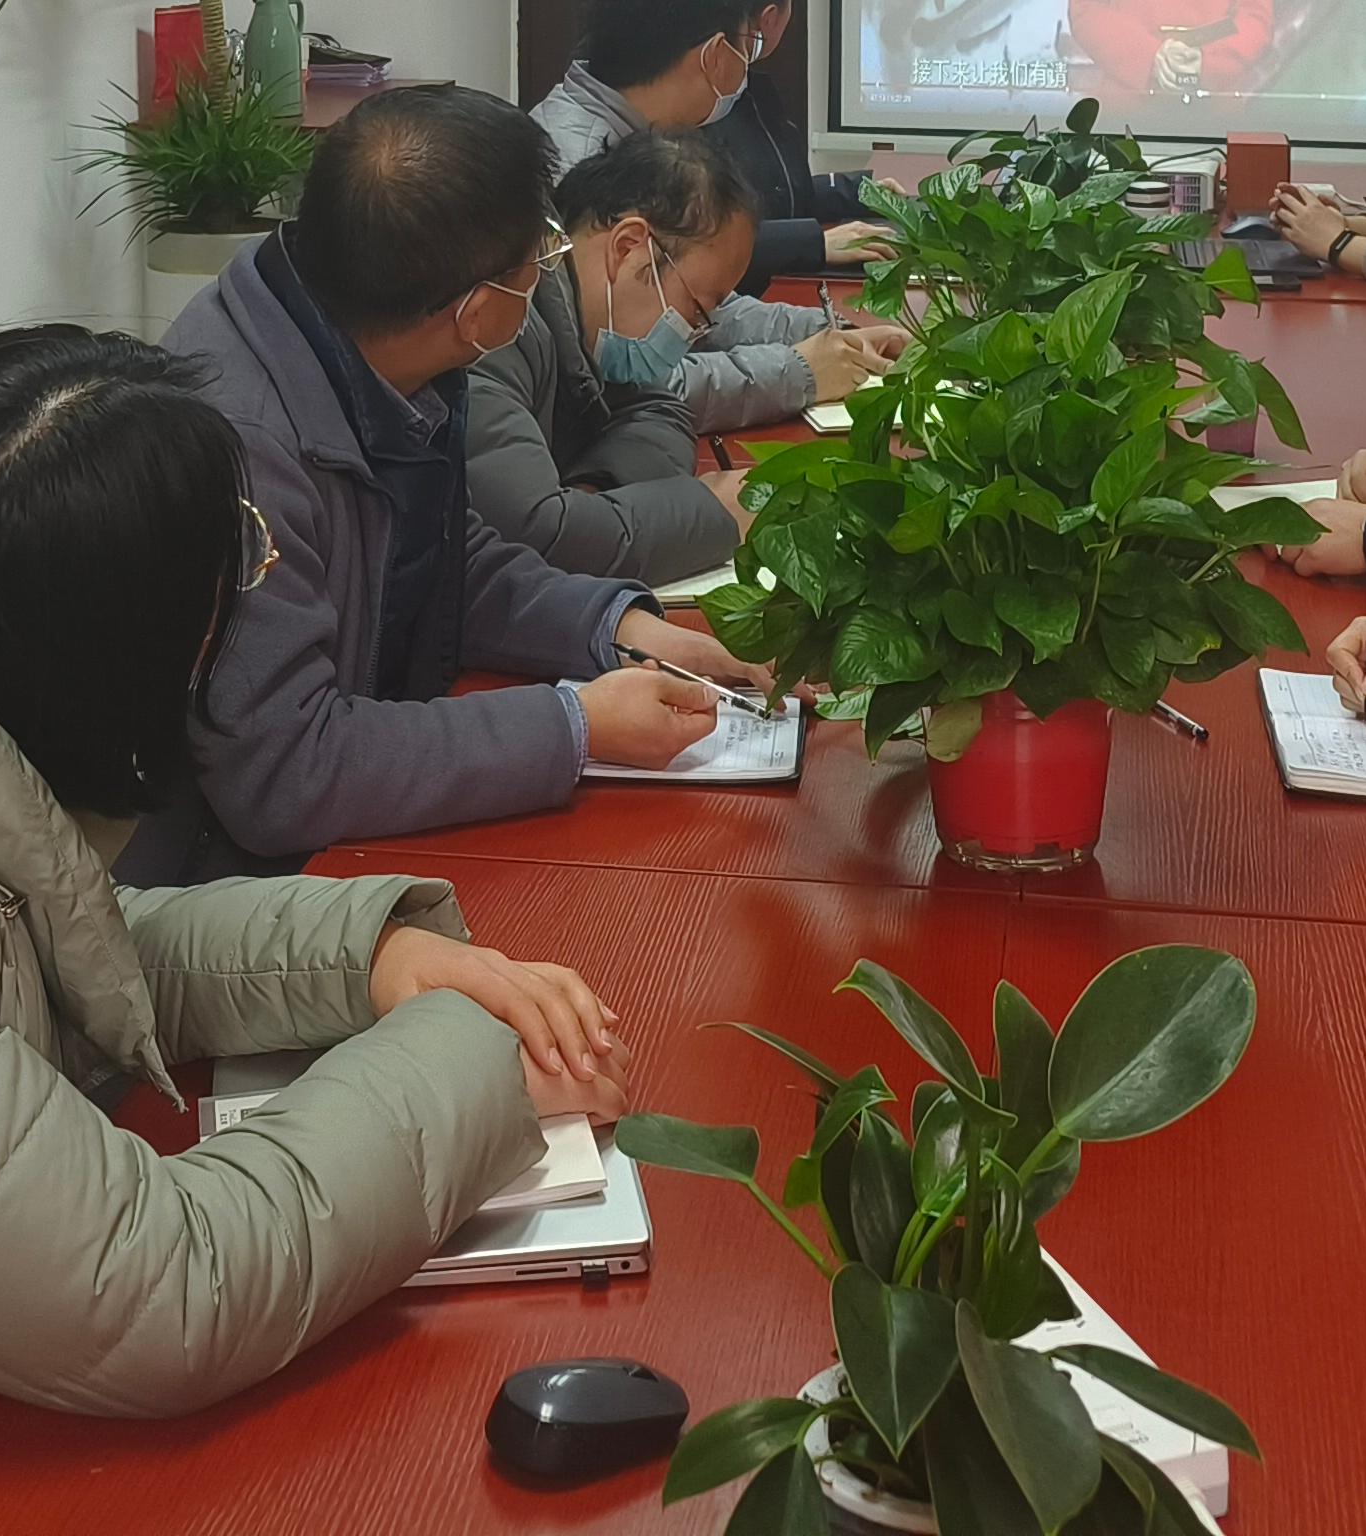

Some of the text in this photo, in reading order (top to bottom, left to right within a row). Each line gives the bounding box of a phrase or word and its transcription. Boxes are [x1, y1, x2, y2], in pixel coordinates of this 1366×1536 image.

[912, 57, 1068, 88] 接下来让我们有请
